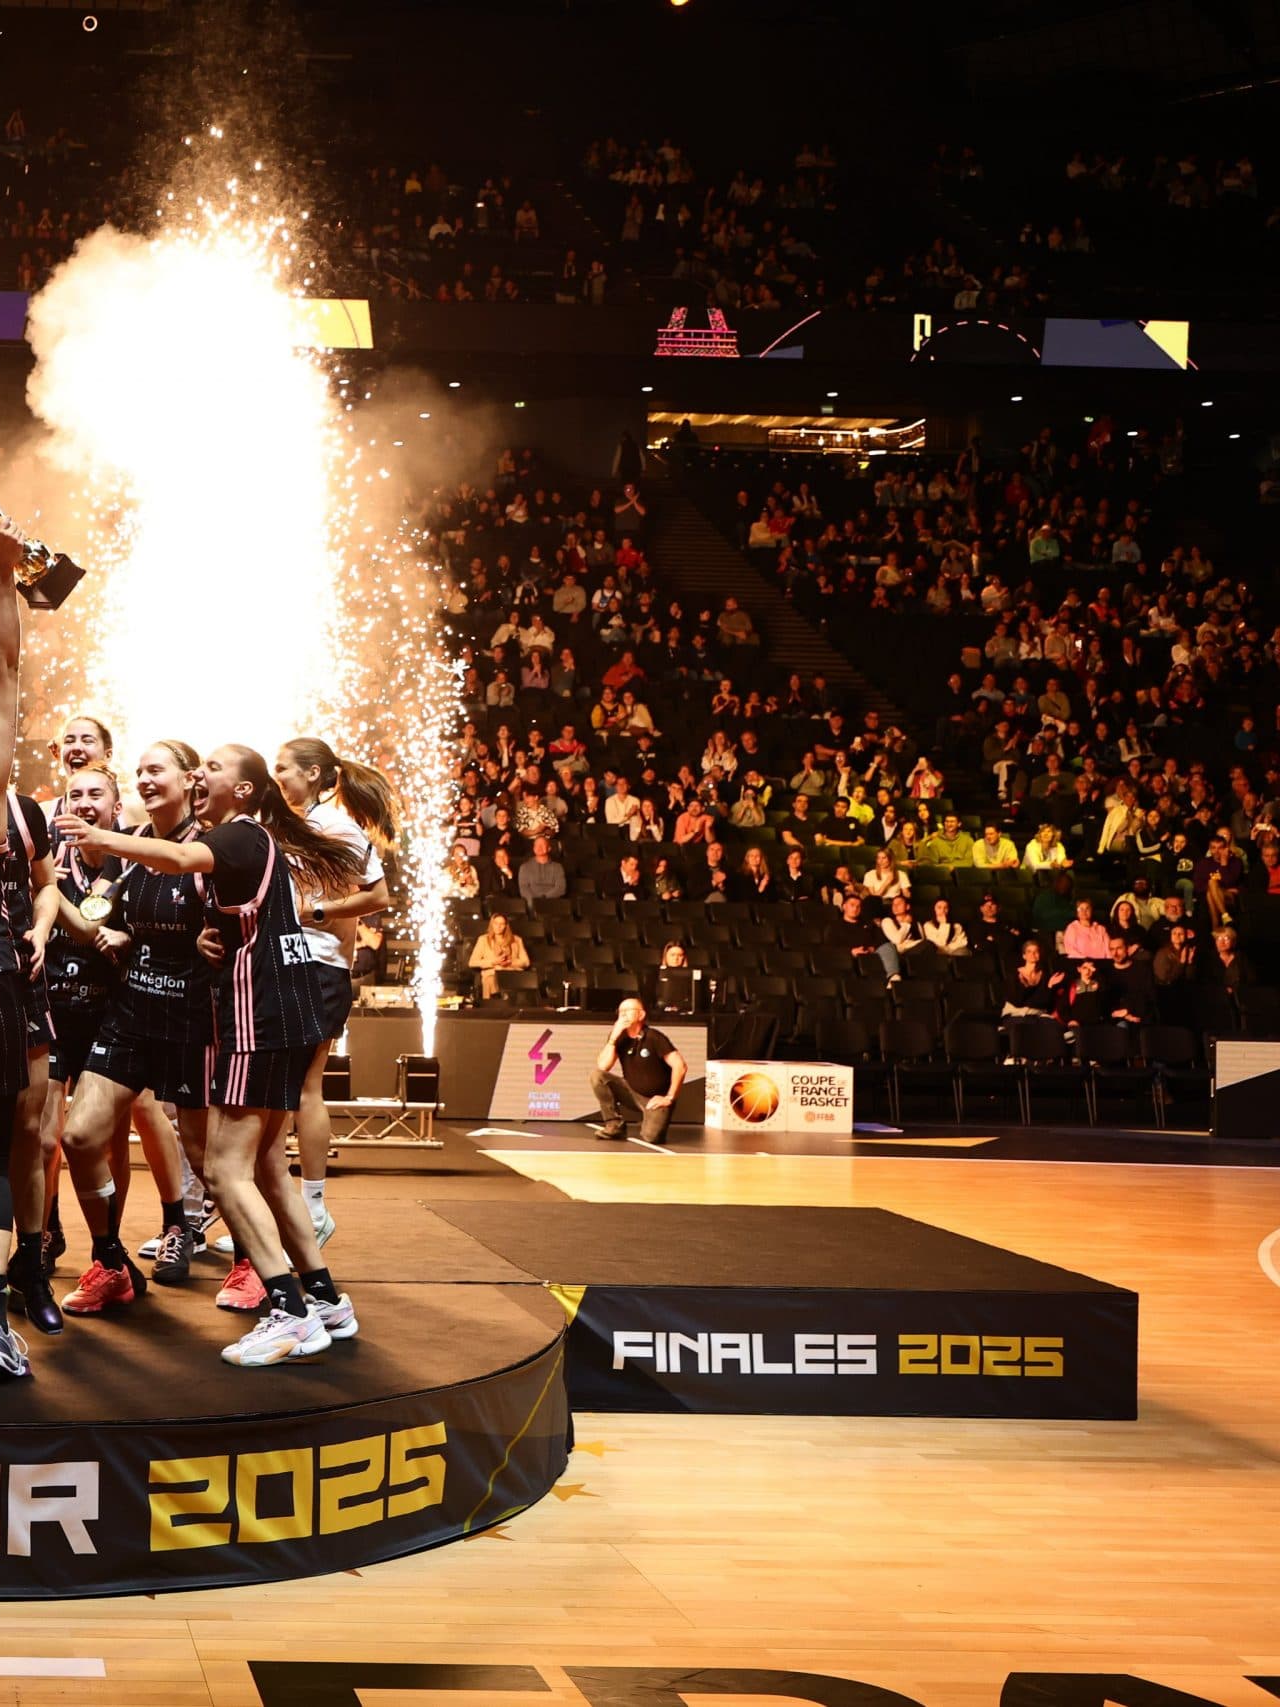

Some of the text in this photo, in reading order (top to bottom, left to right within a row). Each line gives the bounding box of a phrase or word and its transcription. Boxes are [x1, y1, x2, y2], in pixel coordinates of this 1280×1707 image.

[139, 971, 186, 990] Région
[791, 1075, 836, 1086] COUPE
[792, 1086, 846, 1097] FRANCE
[528, 1100, 561, 1110] ASVEL
[800, 1097, 850, 1108] BASKET
[612, 1330, 1064, 1377] FINALES 2025
[148, 1421, 448, 1552] 2025
